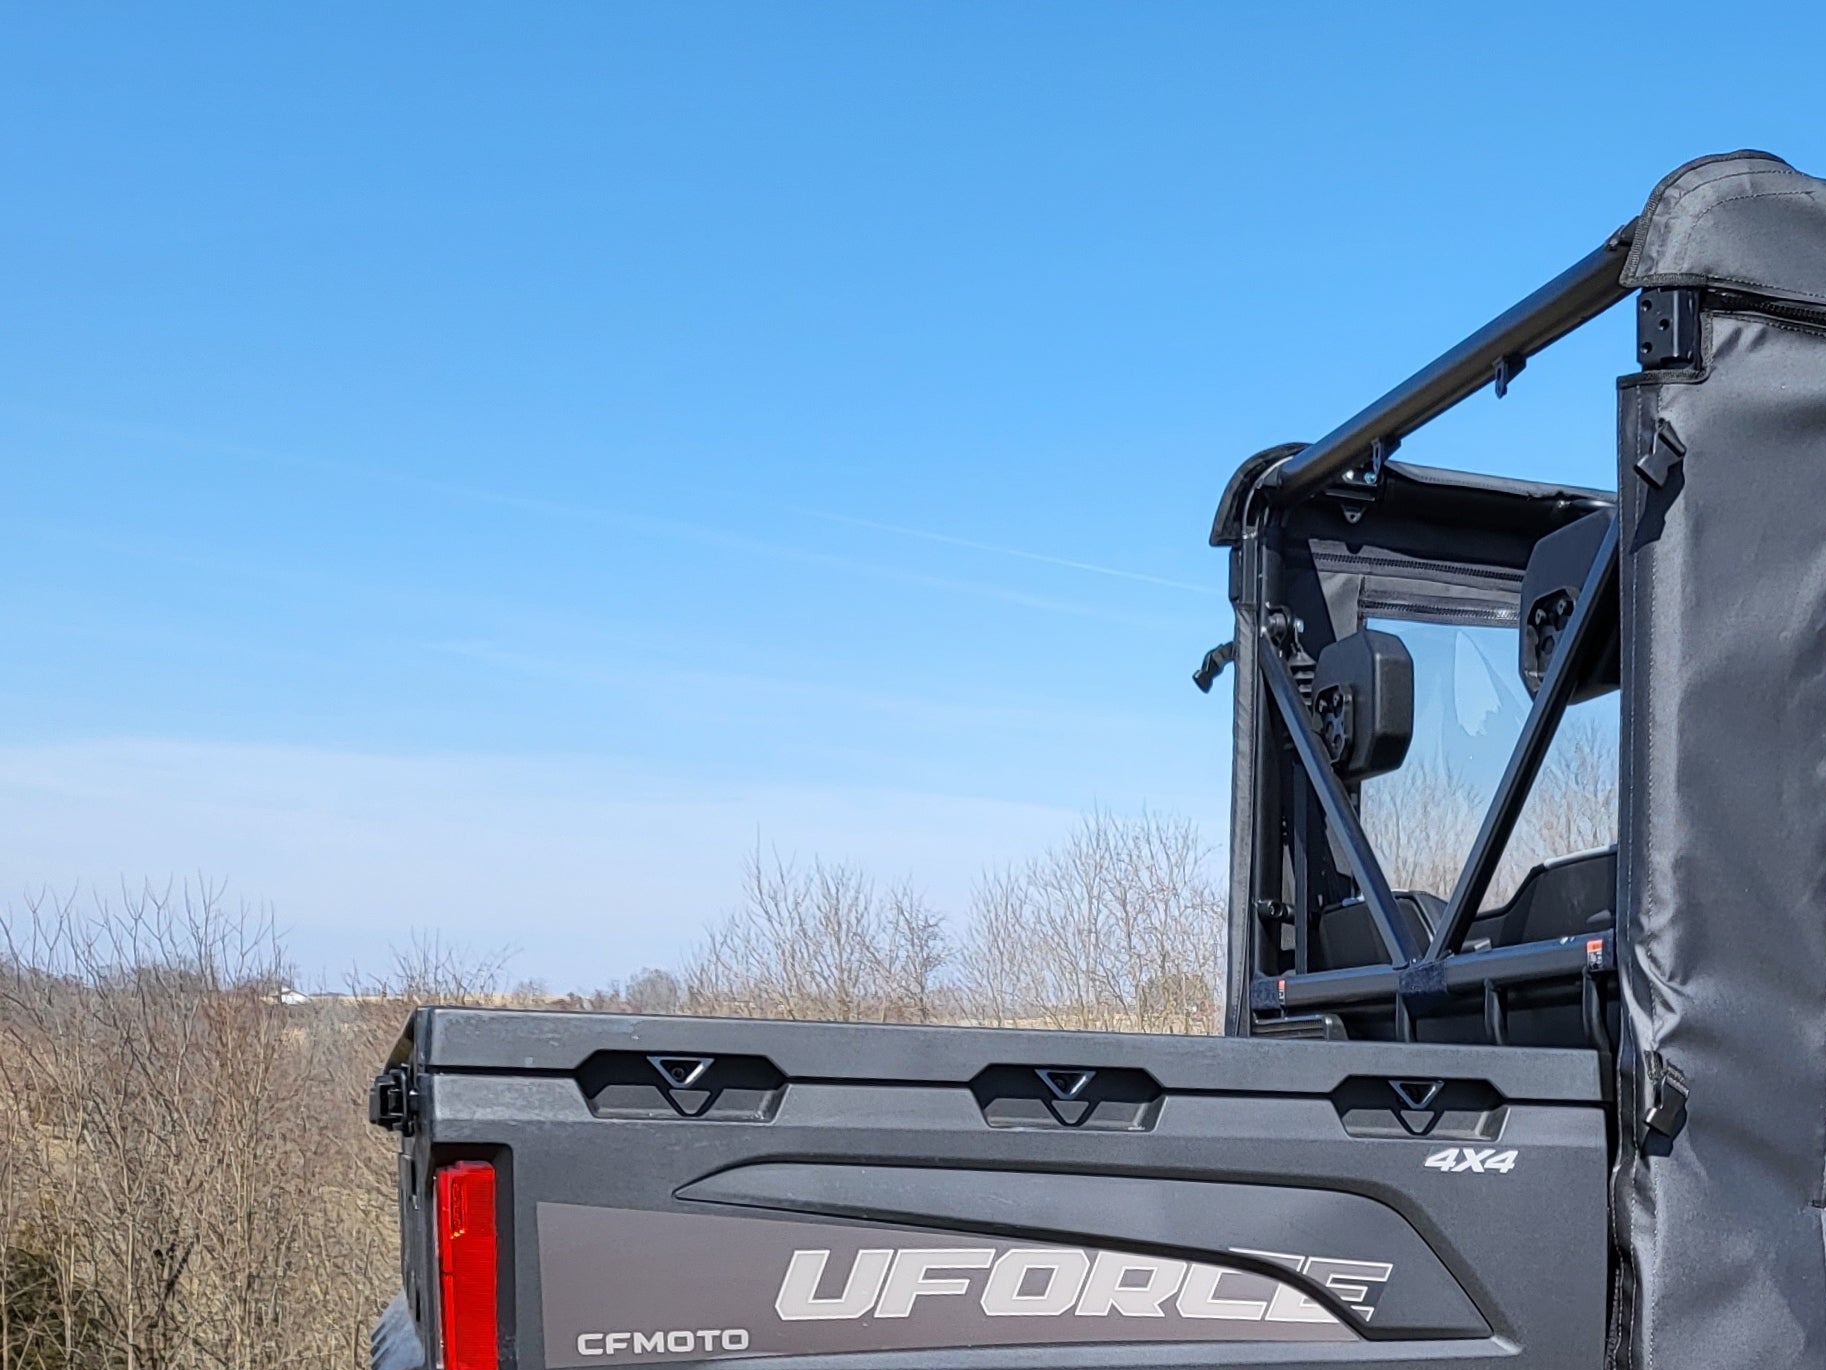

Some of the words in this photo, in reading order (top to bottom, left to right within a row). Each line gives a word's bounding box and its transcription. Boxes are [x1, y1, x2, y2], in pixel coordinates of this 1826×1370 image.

[1424, 1147, 1518, 1173] 4X4
[774, 1247, 1393, 1323] UFORCE
[577, 1328, 750, 1356] CFMOTO
